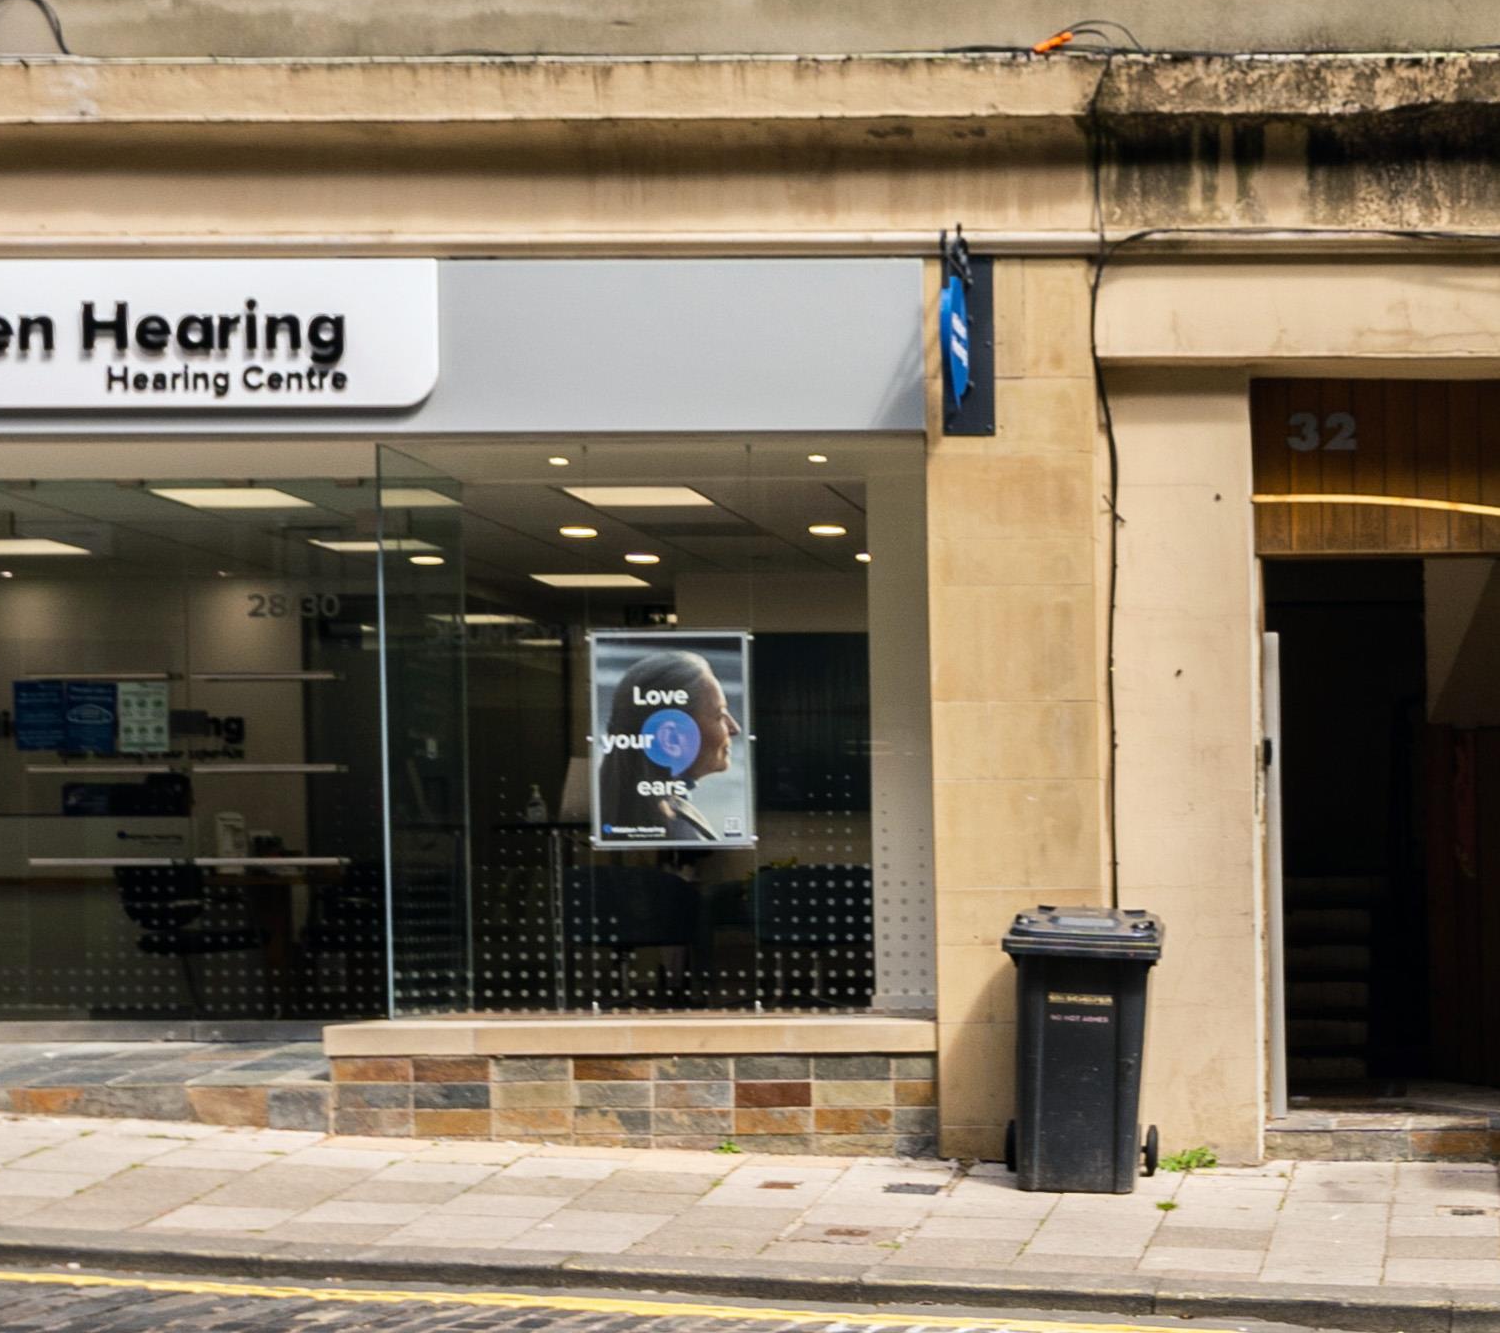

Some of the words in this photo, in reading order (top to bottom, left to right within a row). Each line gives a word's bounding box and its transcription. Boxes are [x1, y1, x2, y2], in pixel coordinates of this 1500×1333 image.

[81, 298, 345, 365] Hearing
[107, 364, 230, 398] Hearing
[243, 365, 348, 392] Centre
[1287, 412, 1357, 451] 32
[633, 686, 689, 705] Love
[601, 733, 654, 754] your
[637, 780, 689, 796] ears
